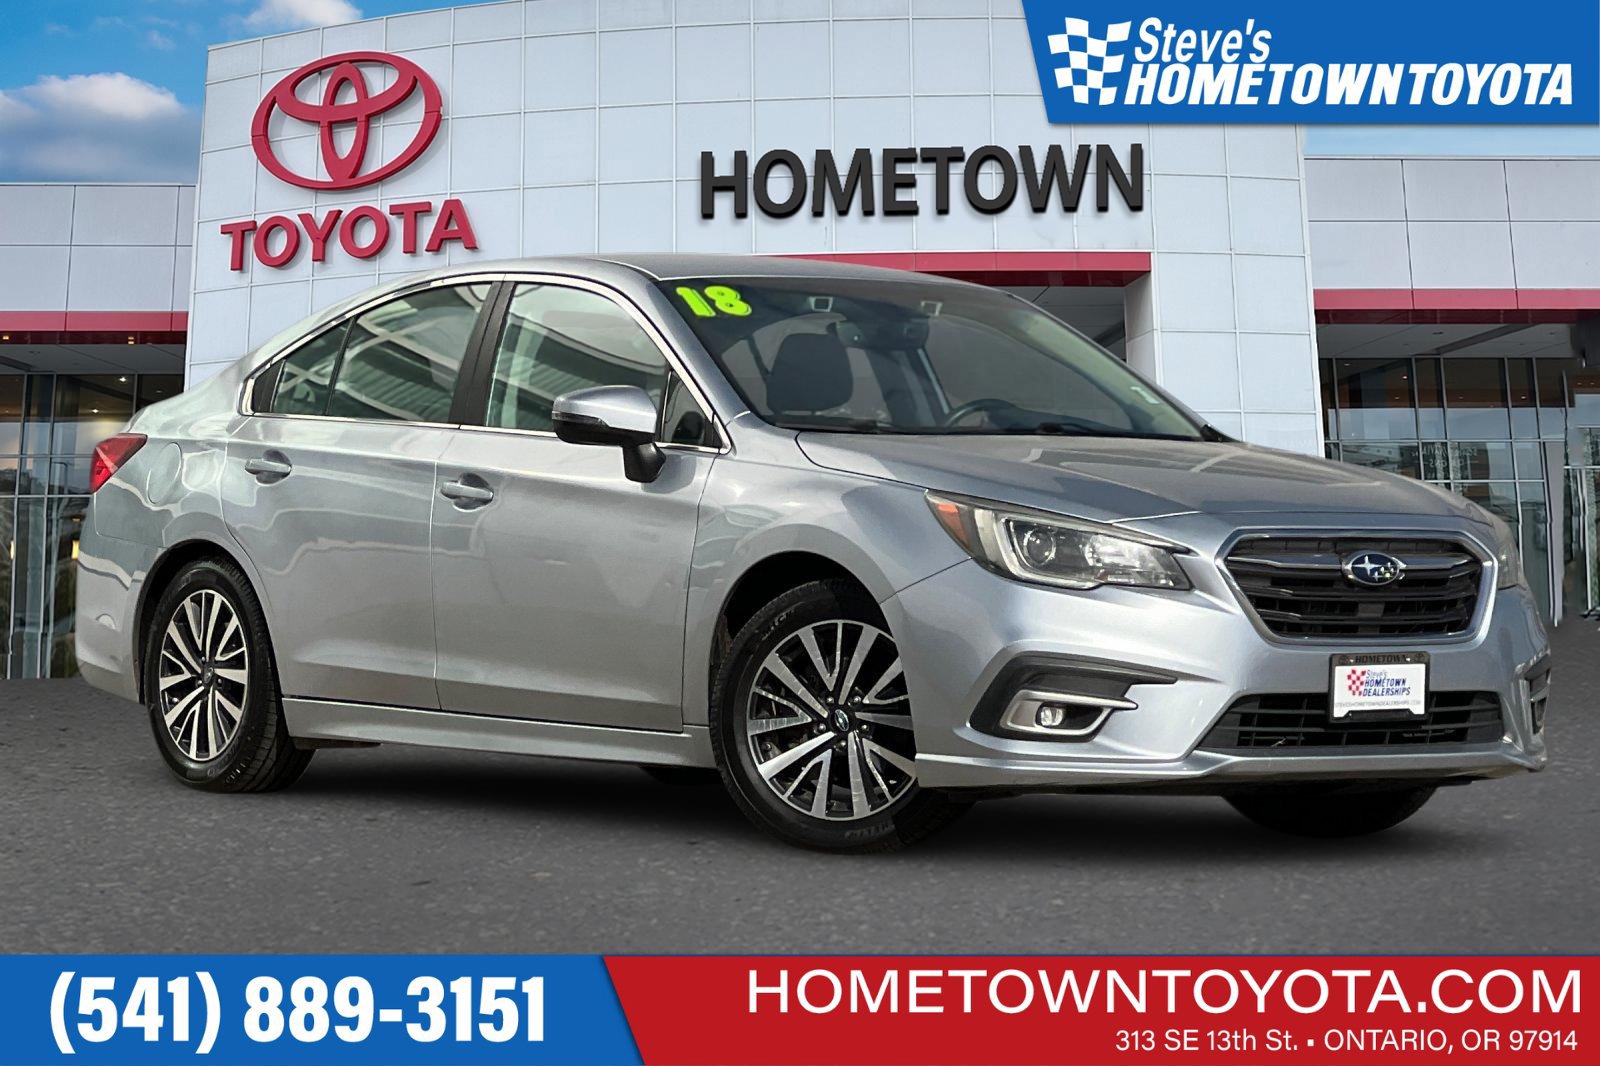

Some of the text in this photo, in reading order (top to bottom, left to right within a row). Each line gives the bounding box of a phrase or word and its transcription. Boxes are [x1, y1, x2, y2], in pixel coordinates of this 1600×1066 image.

[700, 143, 1145, 220] HOMETOWN
[220, 198, 479, 272] TOYOTA
[675, 284, 752, 318] 18
[1363, 687, 1411, 696] DEALERSHIPS
[1365, 679, 1406, 687] HOMETOWN
